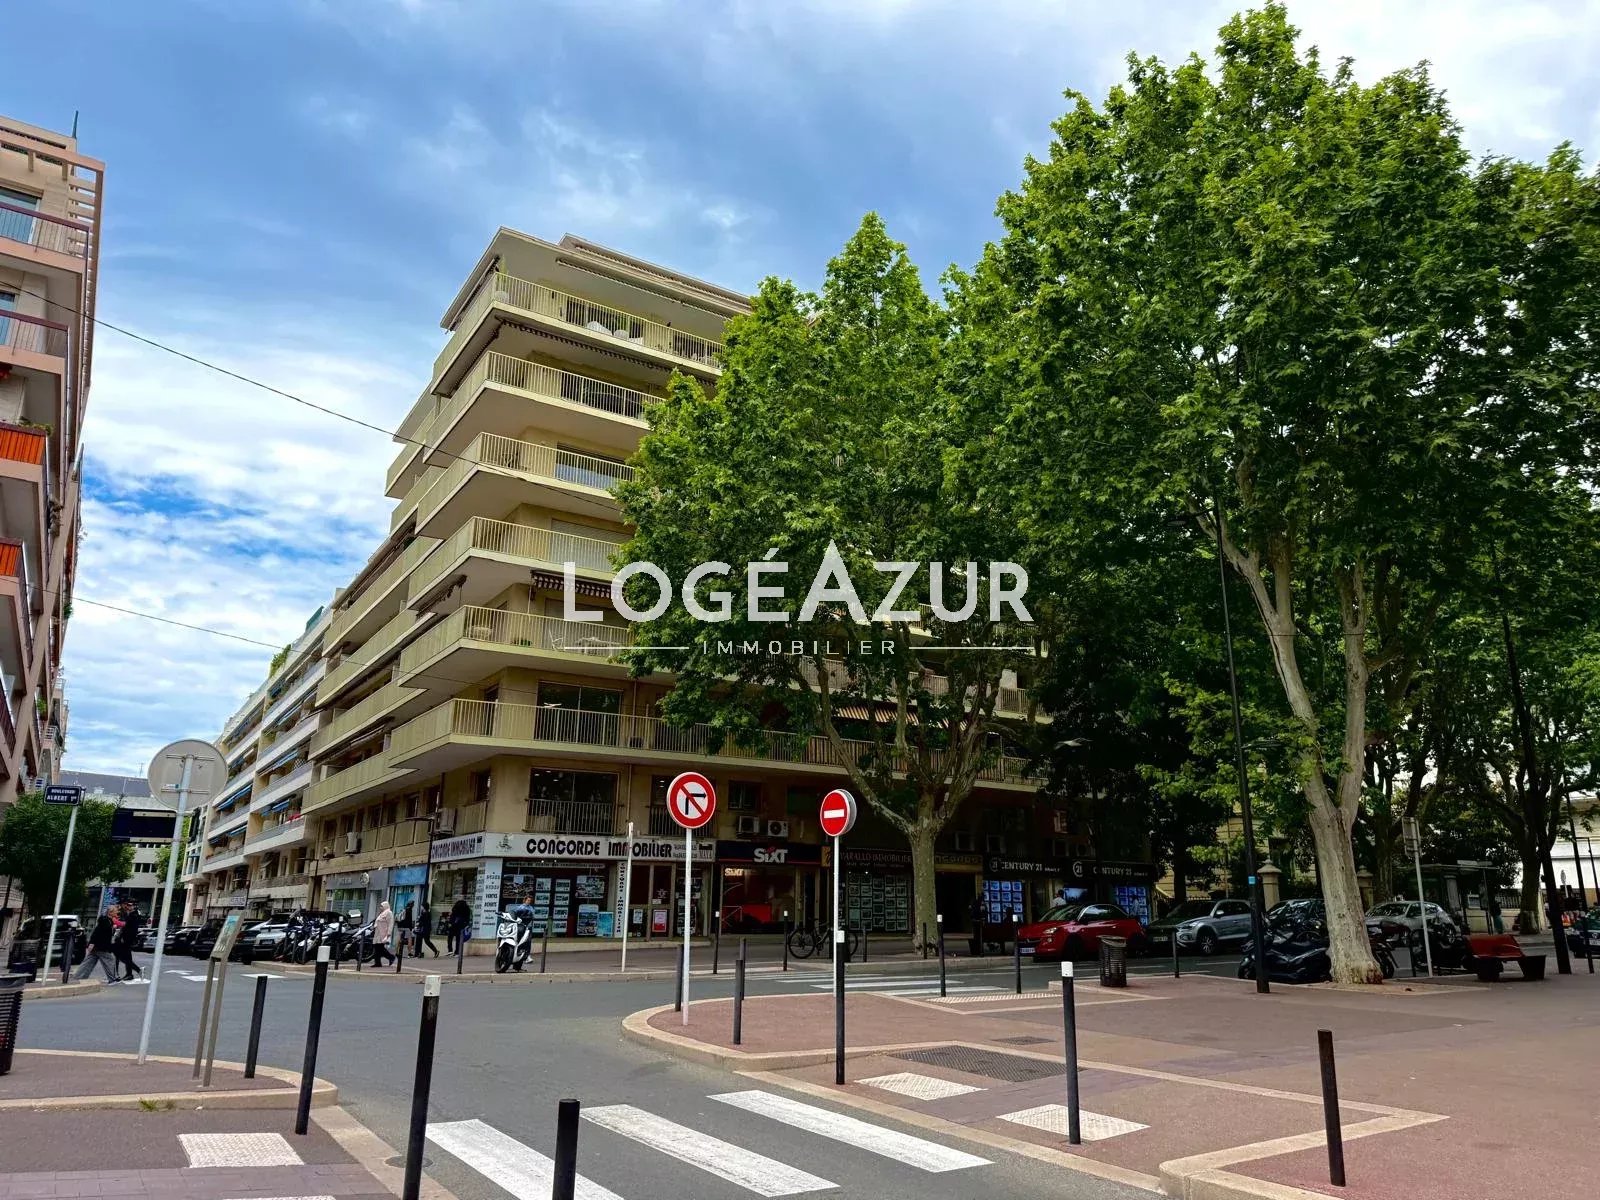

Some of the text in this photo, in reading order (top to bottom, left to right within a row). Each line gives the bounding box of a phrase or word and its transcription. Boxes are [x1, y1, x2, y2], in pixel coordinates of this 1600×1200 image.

[526, 838, 600, 856] CONCORDE
[608, 839, 672, 857] IMMOBILIER
[1000, 860, 1034, 872] CENTURY
[1035, 863, 1043, 872] 21
[1092, 866, 1124, 876] CNTURY
[1125, 867, 1133, 877] 21
